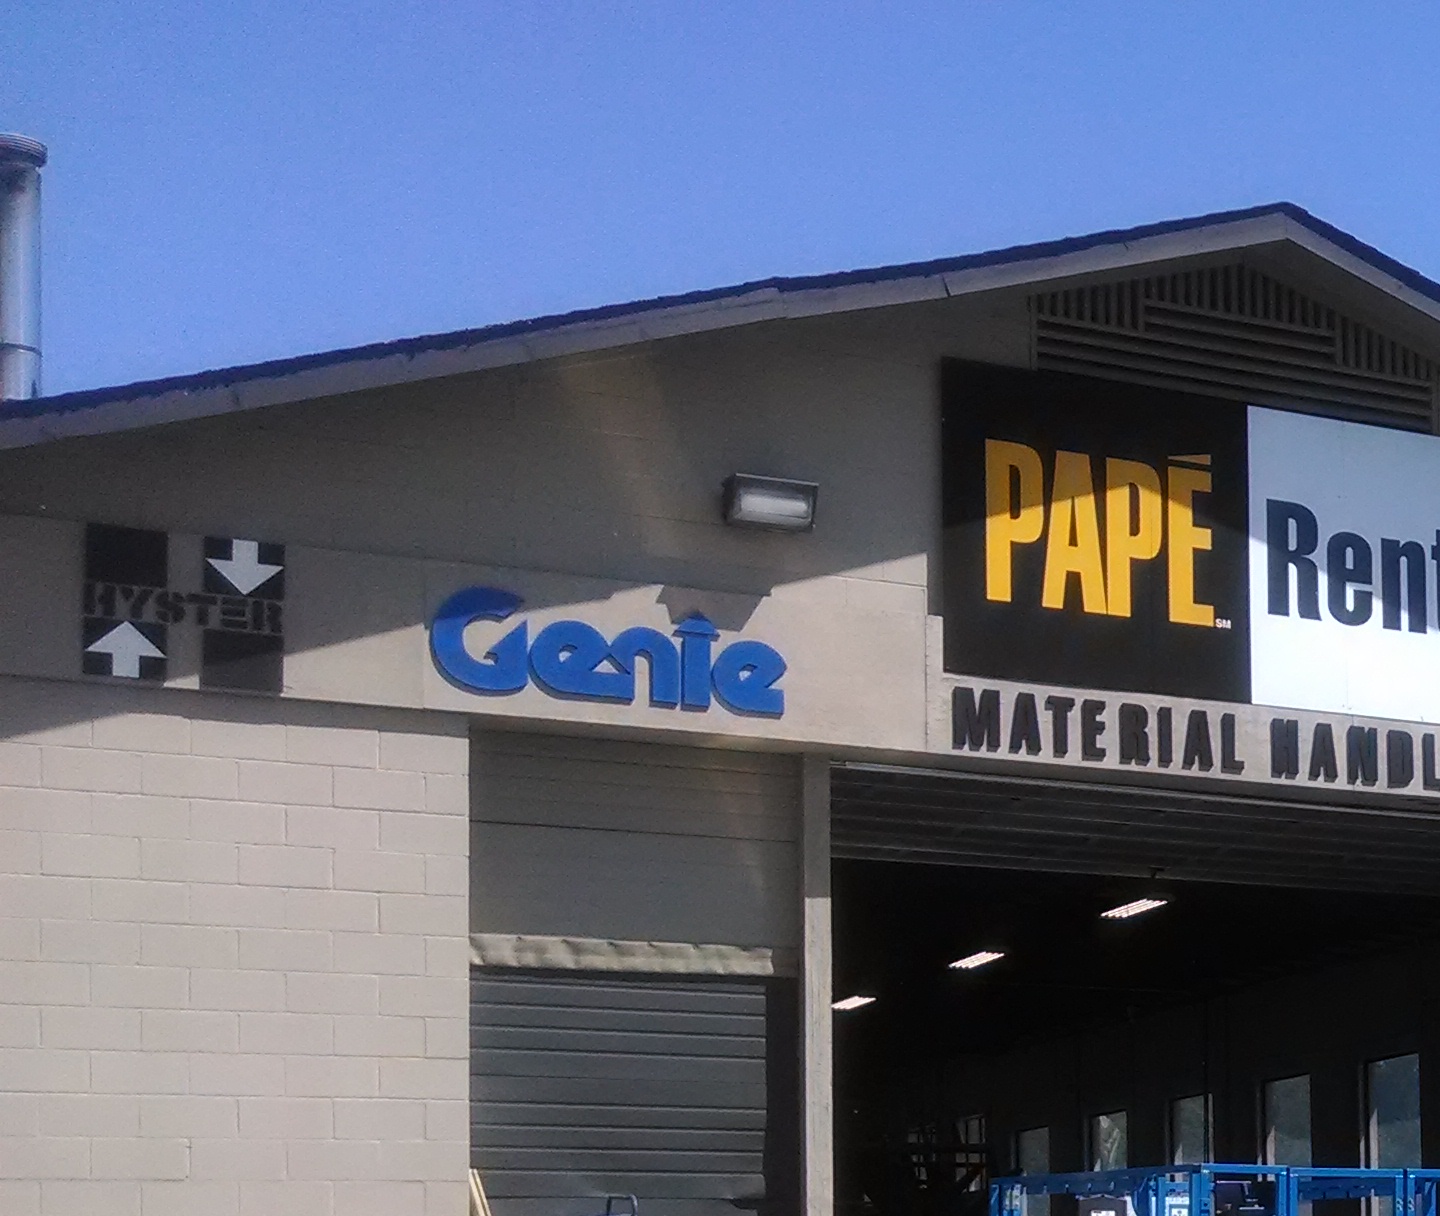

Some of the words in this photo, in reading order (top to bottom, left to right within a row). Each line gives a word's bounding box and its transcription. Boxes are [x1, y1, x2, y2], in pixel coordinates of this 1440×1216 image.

[984, 439, 1214, 628] PAPÉ
[83, 582, 283, 635] HYSTER
[429, 585, 786, 718] Genie
[951, 686, 1245, 775] MATERIAL
